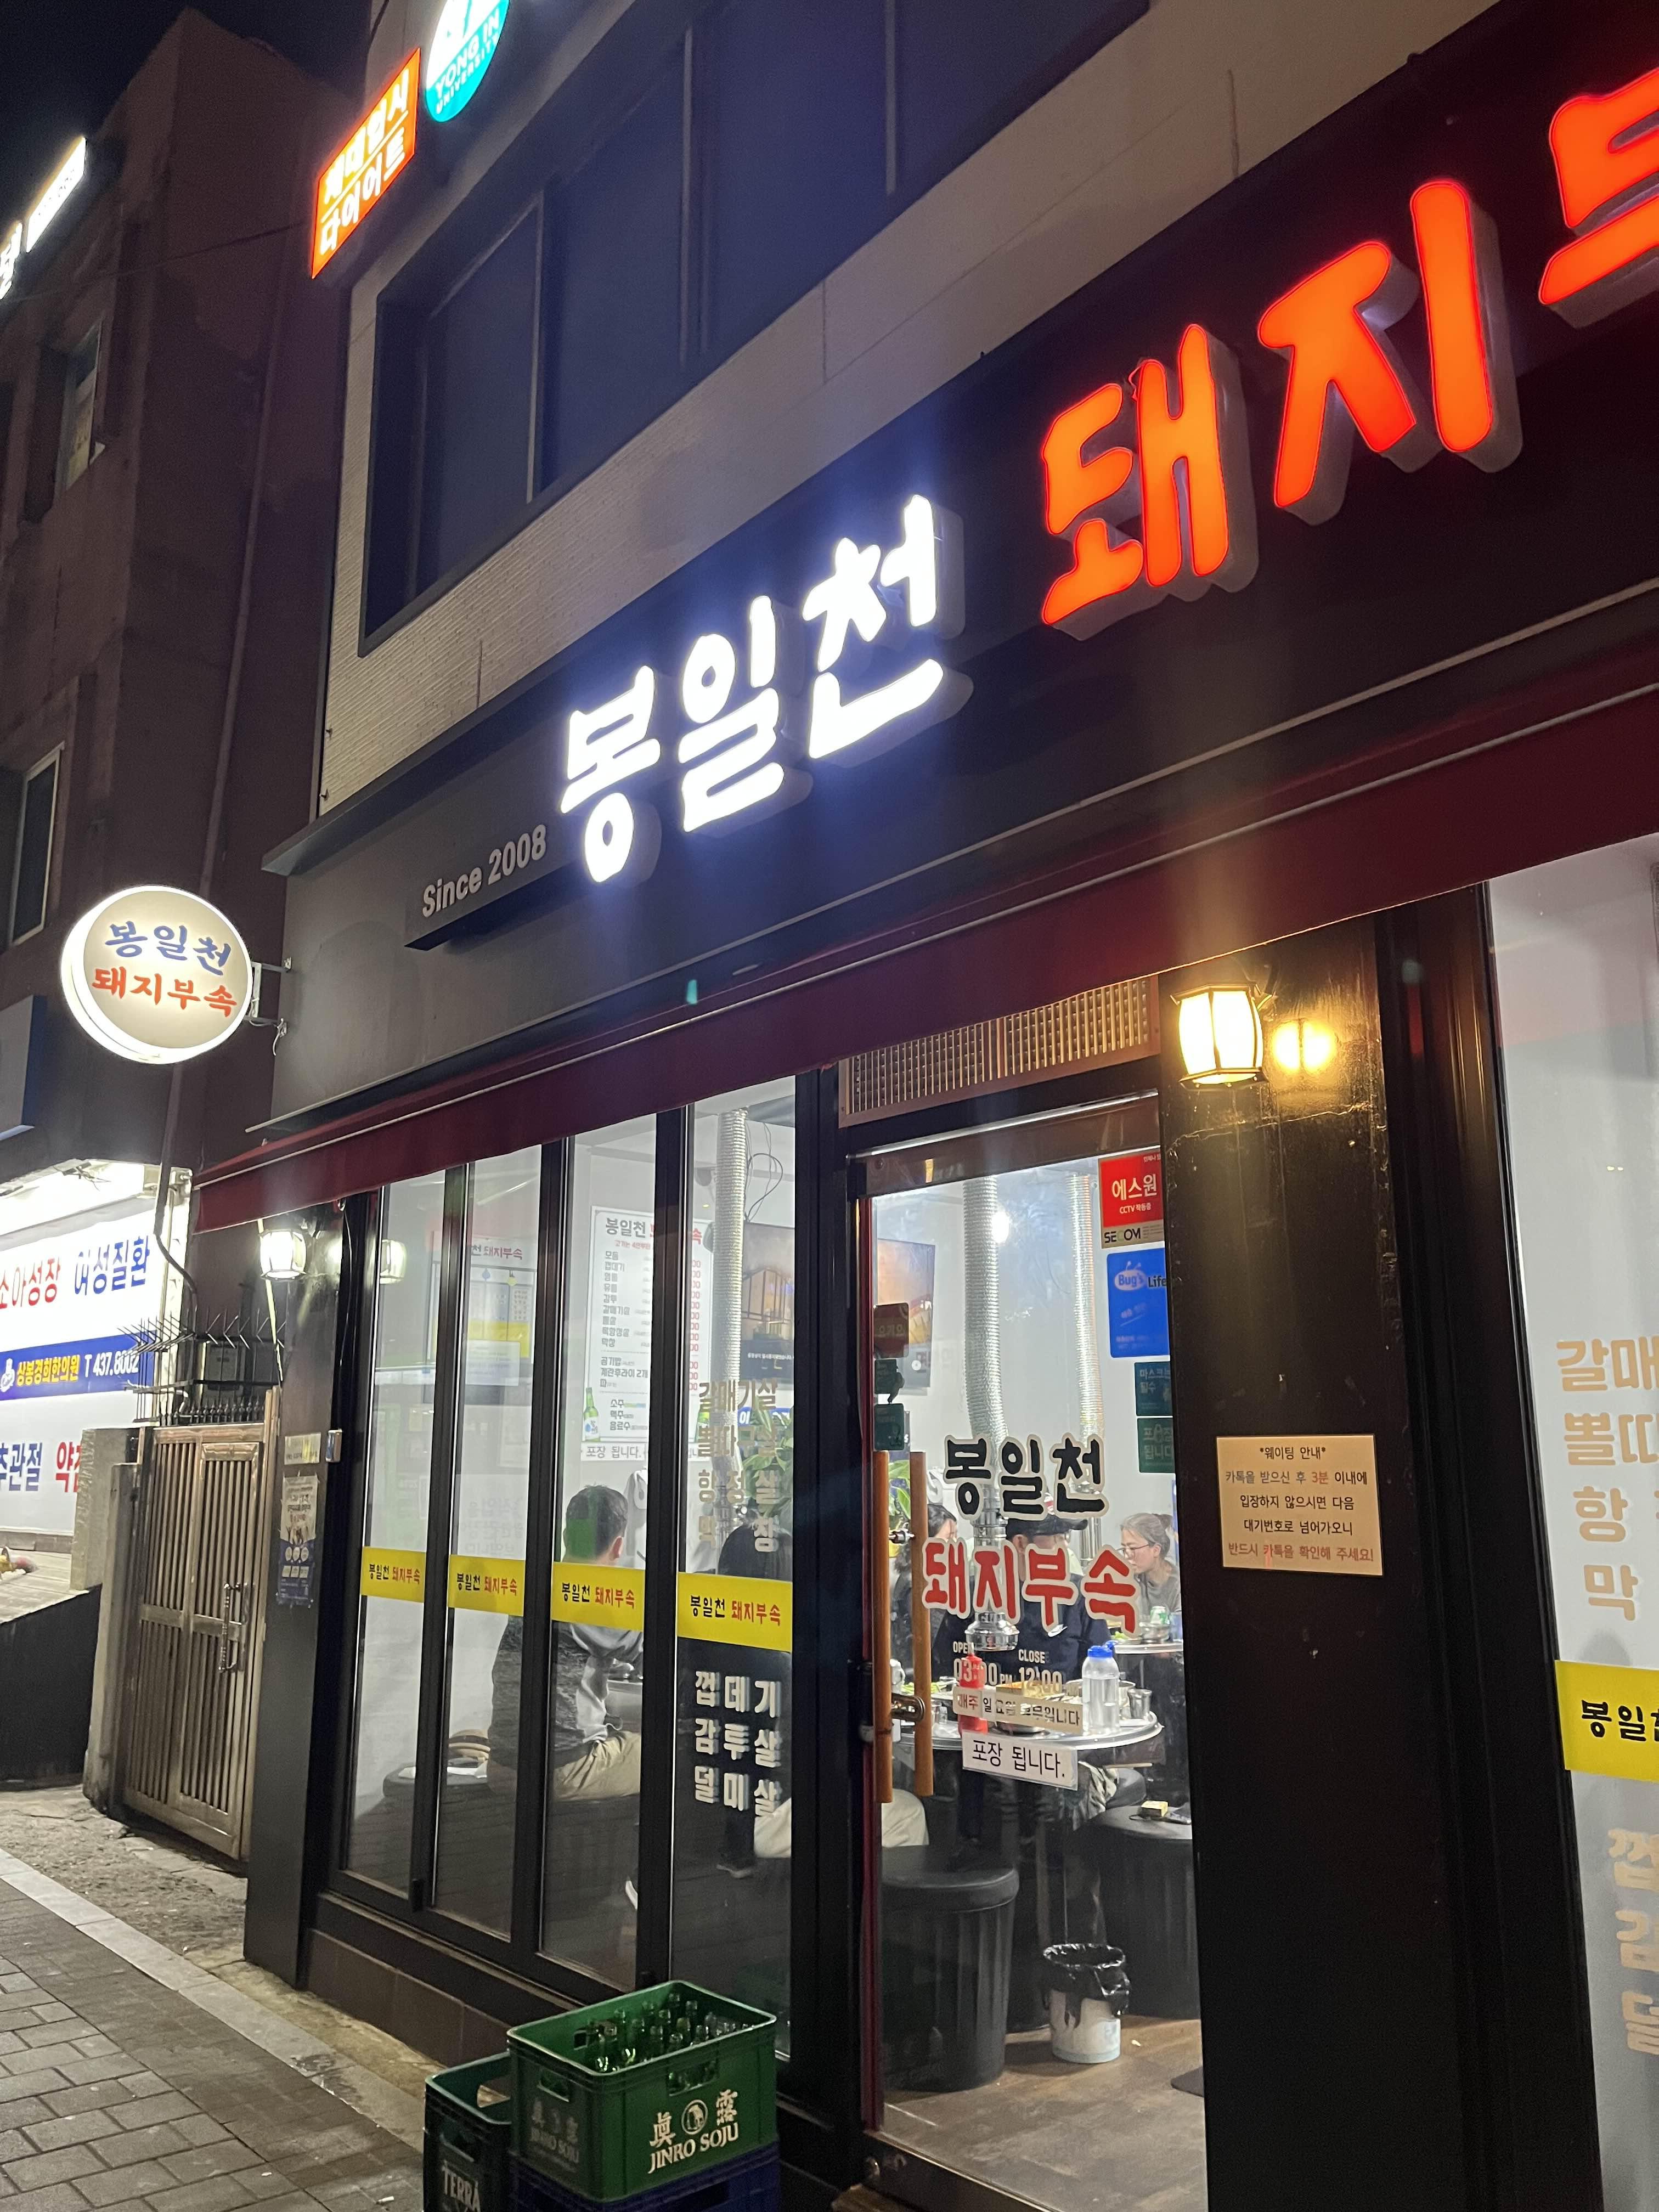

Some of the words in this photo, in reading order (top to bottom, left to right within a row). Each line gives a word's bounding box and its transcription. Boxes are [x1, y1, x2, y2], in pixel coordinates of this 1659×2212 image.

[436, 35, 479, 99] YONG
[320, 127, 405, 255] 다이어트
[560, 494, 945, 883] 봉일천
[422, 867, 483, 918] Since
[488, 825, 546, 885] 2008
[105, 921, 233, 977] 봉일천
[91, 966, 238, 1018] 돼지부속
[1111, 1173, 1158, 1201] 에스원
[1119, 1205, 1136, 1214] CCTV
[606, 1217, 646, 1239] 봉일천
[483, 1245, 523, 1261] 돼지부속
[0, 1256, 61, 1310] 소아성장
[75, 1235, 150, 1296] 여성질환
[1148, 1276, 1167, 1288] Life
[16, 1355, 81, 1387] 상봉경희한의원
[84, 1353, 93, 1378] T
[601, 1356, 622, 1366] 공기밥
[601, 1367, 635, 1378] 계란후라이
[636, 1369, 648, 1378] 2개
[610, 1399, 624, 1408] 소주
[699, 1377, 778, 1413] 갈매기살
[610, 1410, 624, 1419] 맥주
[610, 1421, 630, 1431] 음료수
[586, 1446, 606, 1459] 포장
[611, 1446, 642, 1459] 됩니다.
[944, 1436, 1107, 1516] 봉일천
[1226, 1470, 1255, 1485] 카톡을
[1260, 1470, 1290, 1485] 받으신
[1296, 1471, 1306, 1485] 후
[1312, 1471, 1329, 1485] 3분
[1334, 1471, 1368, 1485] 이내에
[1240, 1494, 1279, 1509] 입장하지
[1285, 1496, 1327, 1510] 않으시면
[1332, 1496, 1355, 1511] 다음
[1573, 1486, 1659, 1542] 항
[1244, 1519, 1294, 1533] 대기번호로
[1300, 1520, 1353, 1536] 넘어가오니
[1228, 1542, 1258, 1556] 반드시
[1263, 1543, 1294, 1558] 카톡을
[1299, 1545, 1330, 1560] 확인해
[1336, 1547, 1374, 1561] 주세요!
[369, 1563, 390, 1581] 봉일천
[392, 1566, 420, 1585] 돼지부속
[456, 1573, 481, 1591] 봉일천
[484, 1576, 518, 1596] 돼지부속
[924, 1540, 1137, 1634] 돼지부속
[561, 1582, 590, 1602] 봉일천
[594, 1586, 635, 1610] 돼지부속
[690, 1595, 725, 1618] 봉일천
[731, 1600, 781, 1627] 돼지부속
[953, 1641, 975, 1656] OPEN
[1018, 1649, 1046, 1664] CLOSE
[953, 1658, 998, 1686] 03:00
[1019, 1667, 1063, 1694] 12:00
[695, 1671, 777, 1718] 껍데기
[957, 1694, 979, 1711] 매주
[983, 1697, 992, 1713] 일
[695, 1718, 778, 1768] 감투살
[972, 1740, 1003, 1767] 포장
[1012, 1746, 1065, 1779] 됩니다.
[695, 1765, 778, 1817] 덜미살
[647, 2138, 696, 2174] JINRO
[700, 2121, 739, 2152] SOJU
[441, 2159, 481, 2212] TERRA
